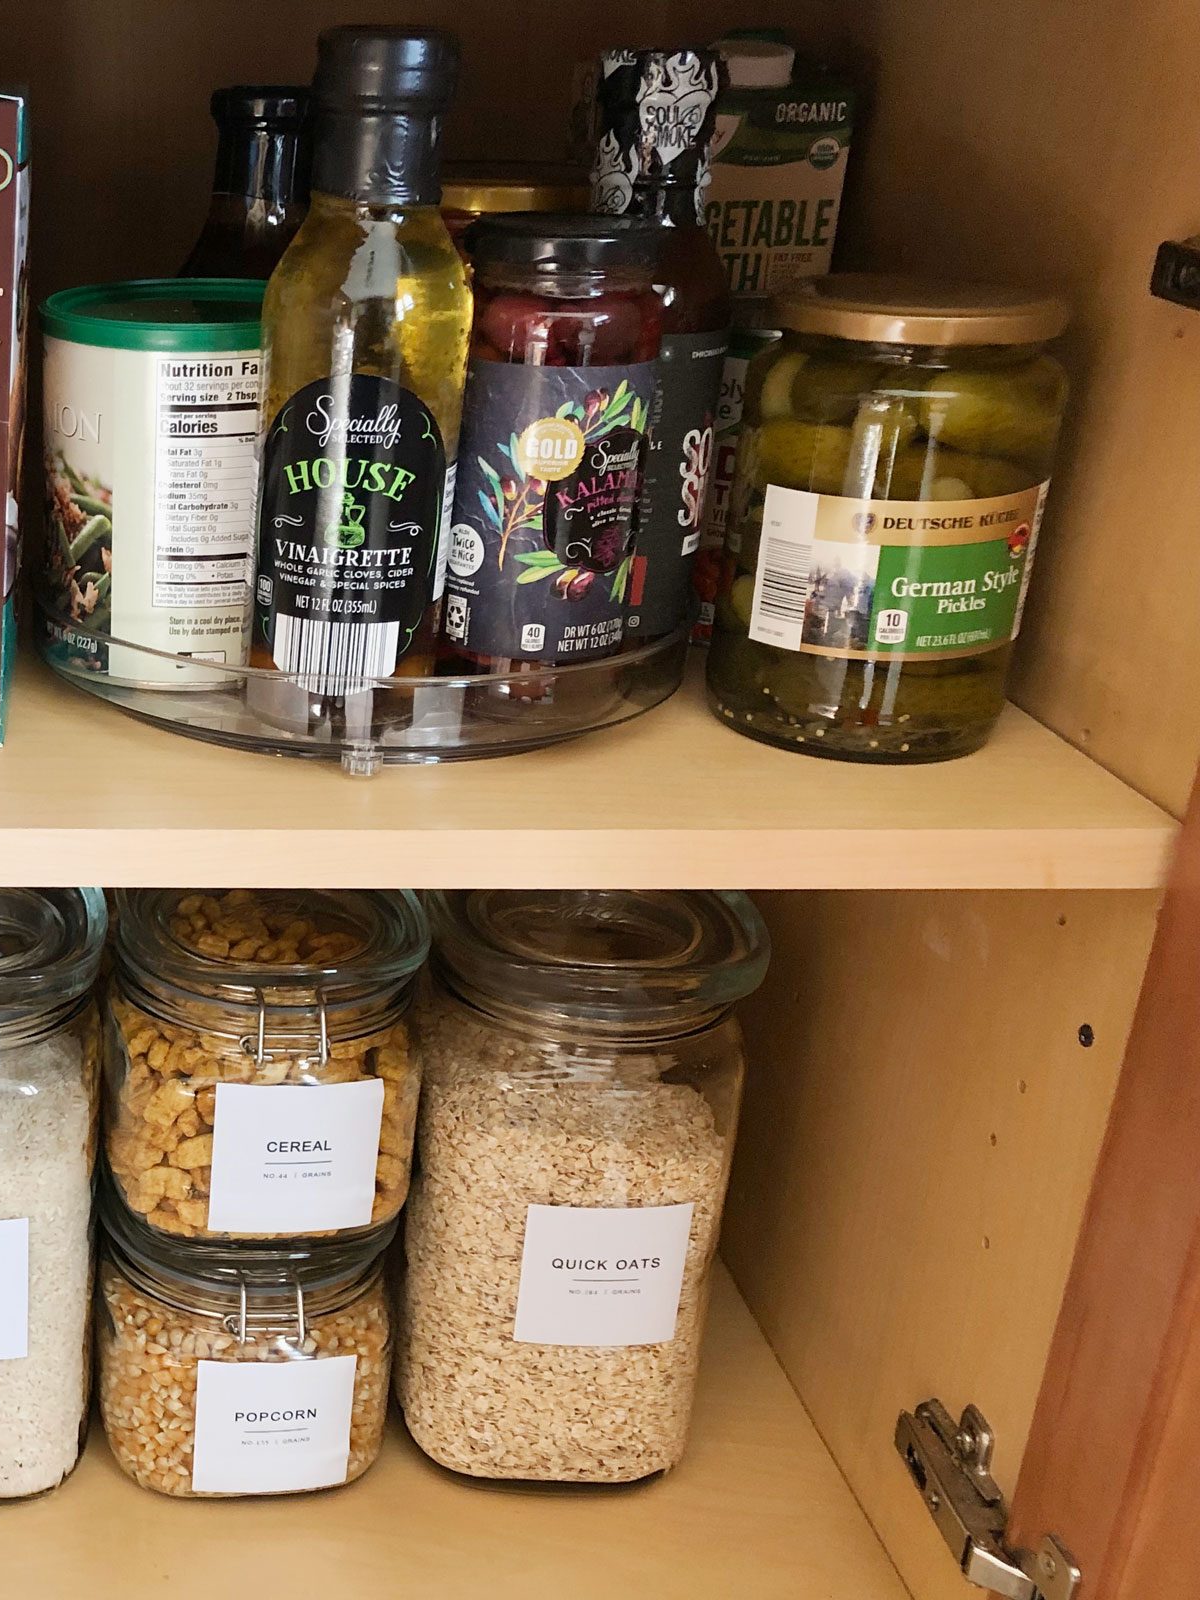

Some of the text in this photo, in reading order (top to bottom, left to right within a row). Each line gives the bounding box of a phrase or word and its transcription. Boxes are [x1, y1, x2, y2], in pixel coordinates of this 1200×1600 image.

[646, 105, 679, 126] SOUL
[775, 102, 847, 123] ORGANIC
[704, 199, 834, 247] GETABLE
[161, 363, 233, 377] Nutrition
[200, 393, 219, 402] size
[236, 392, 256, 400] Tbsp
[161, 420, 217, 433] Calories
[306, 395, 401, 449] Specially
[332, 434, 382, 444] SELECTED
[525, 438, 578, 459] GOLD
[283, 457, 416, 502] HOUSE
[883, 516, 973, 530] DEUTSCHE
[452, 533, 475, 549] Twice
[275, 539, 412, 567] VINAIGRETTE
[458, 551, 475, 563] Nice
[274, 560, 414, 579] WHOLE GARLIC CLOVES, CIDER
[259, 579, 271, 592] 100
[279, 573, 316, 586] VINEGAR
[332, 580, 370, 590] SPECIAL
[374, 580, 406, 589] SPICES
[891, 565, 1019, 597] German Style
[296, 595, 377, 614] NET 12 FL OZ (355mL)
[937, 596, 986, 614] Pickles
[170, 616, 185, 625] Store
[187, 617, 192, 625] in
[200, 617, 212, 625] cool
[214, 616, 223, 626] dry
[225, 616, 241, 625] place.
[886, 613, 900, 627] 10
[182, 627, 189, 636] by
[191, 627, 204, 635] date
[206, 627, 230, 636] stamped
[527, 627, 540, 638] 40
[916, 635, 931, 647] NET
[932, 634, 948, 646] 23.6
[267, 1140, 332, 1153] CEREAL
[552, 1258, 661, 1270] QUICK OATS
[235, 1409, 317, 1422] POPCORN
